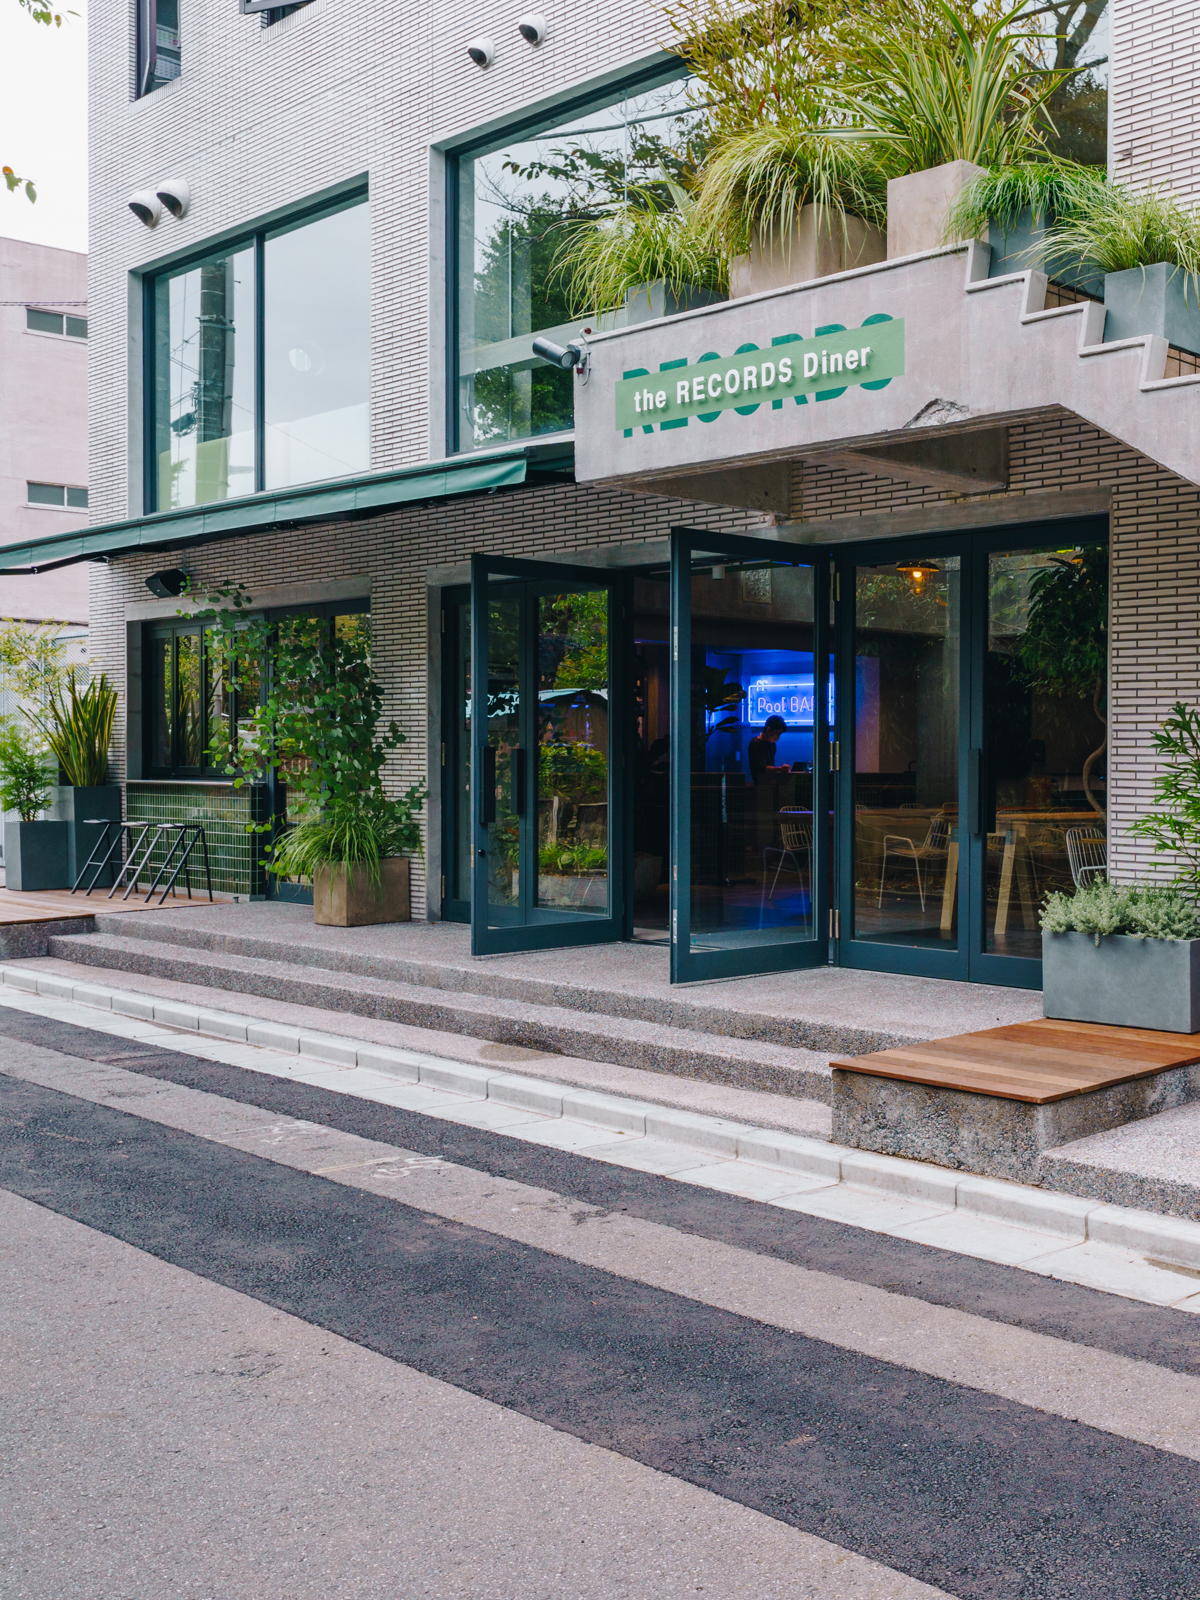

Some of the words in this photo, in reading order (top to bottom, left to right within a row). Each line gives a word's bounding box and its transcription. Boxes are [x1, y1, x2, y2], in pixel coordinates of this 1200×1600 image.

[634, 387, 667, 413] the
[676, 357, 793, 404] RECORDS
[803, 346, 871, 378] Diner
[757, 697, 787, 713] Pool
